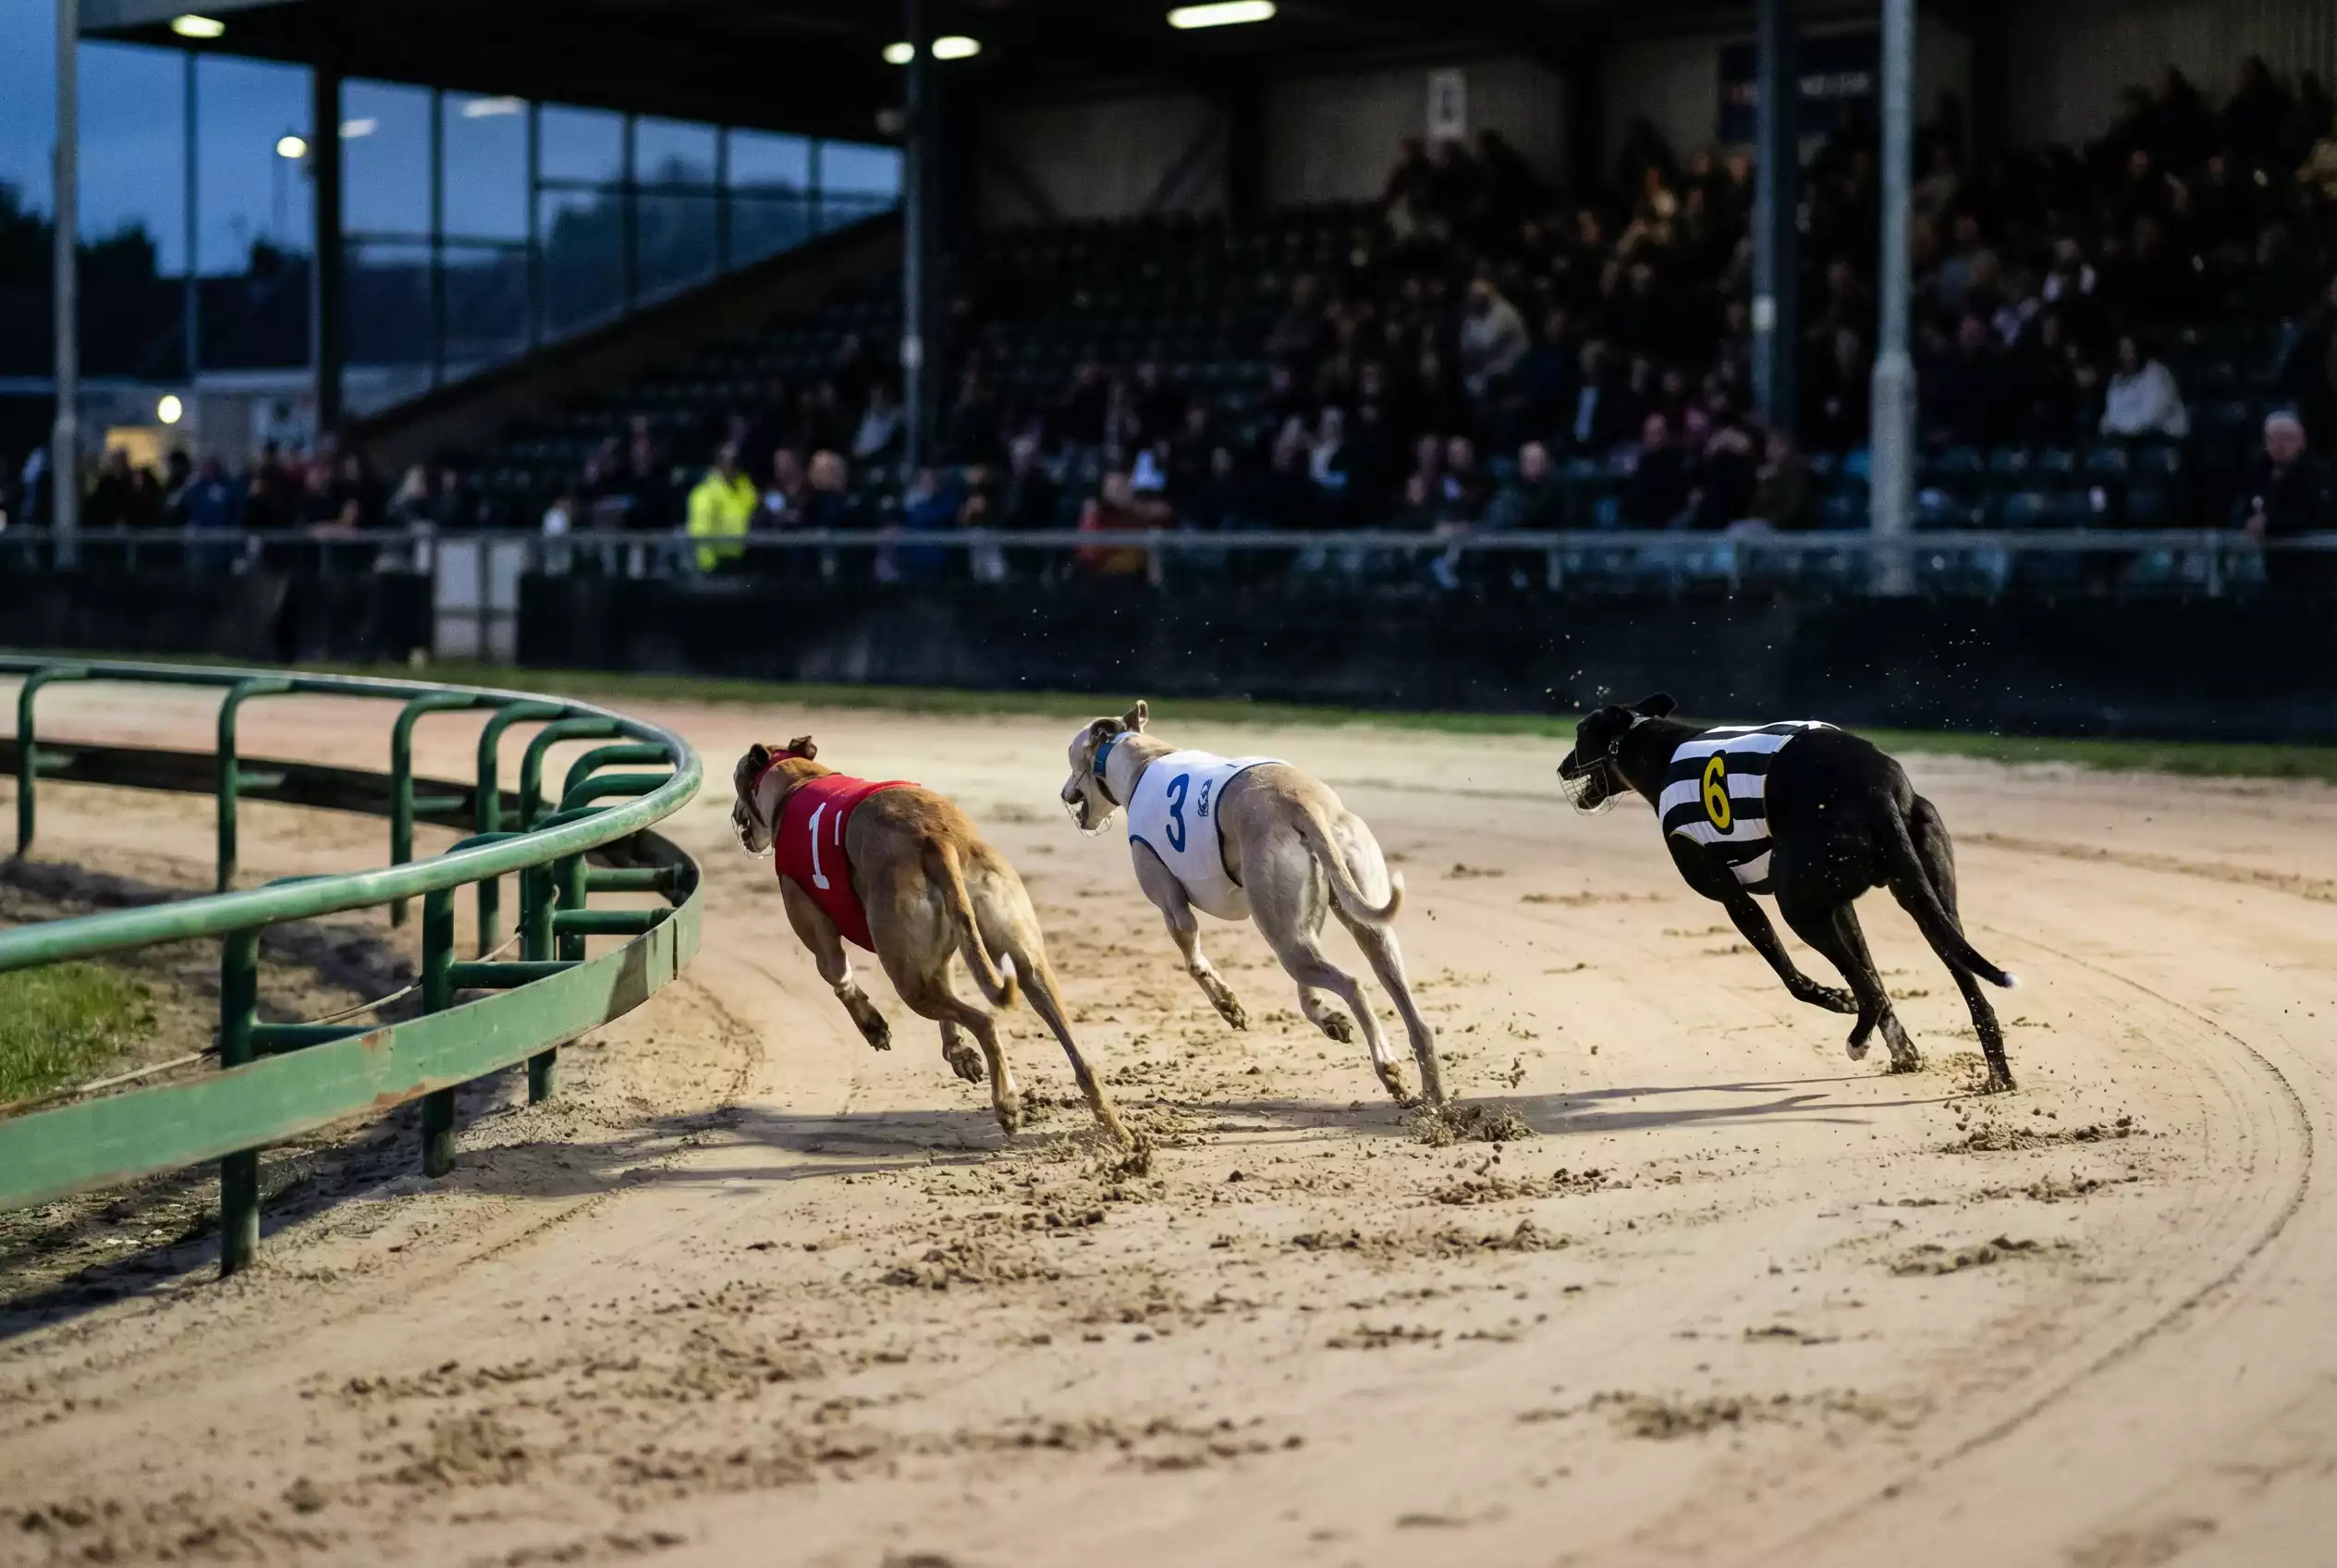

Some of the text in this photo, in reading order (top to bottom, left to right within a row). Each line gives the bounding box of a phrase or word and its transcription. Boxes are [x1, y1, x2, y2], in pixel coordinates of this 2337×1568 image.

[1165, 773, 1190, 853] 3
[1703, 755, 1731, 829] 6
[808, 802, 830, 889] 1
